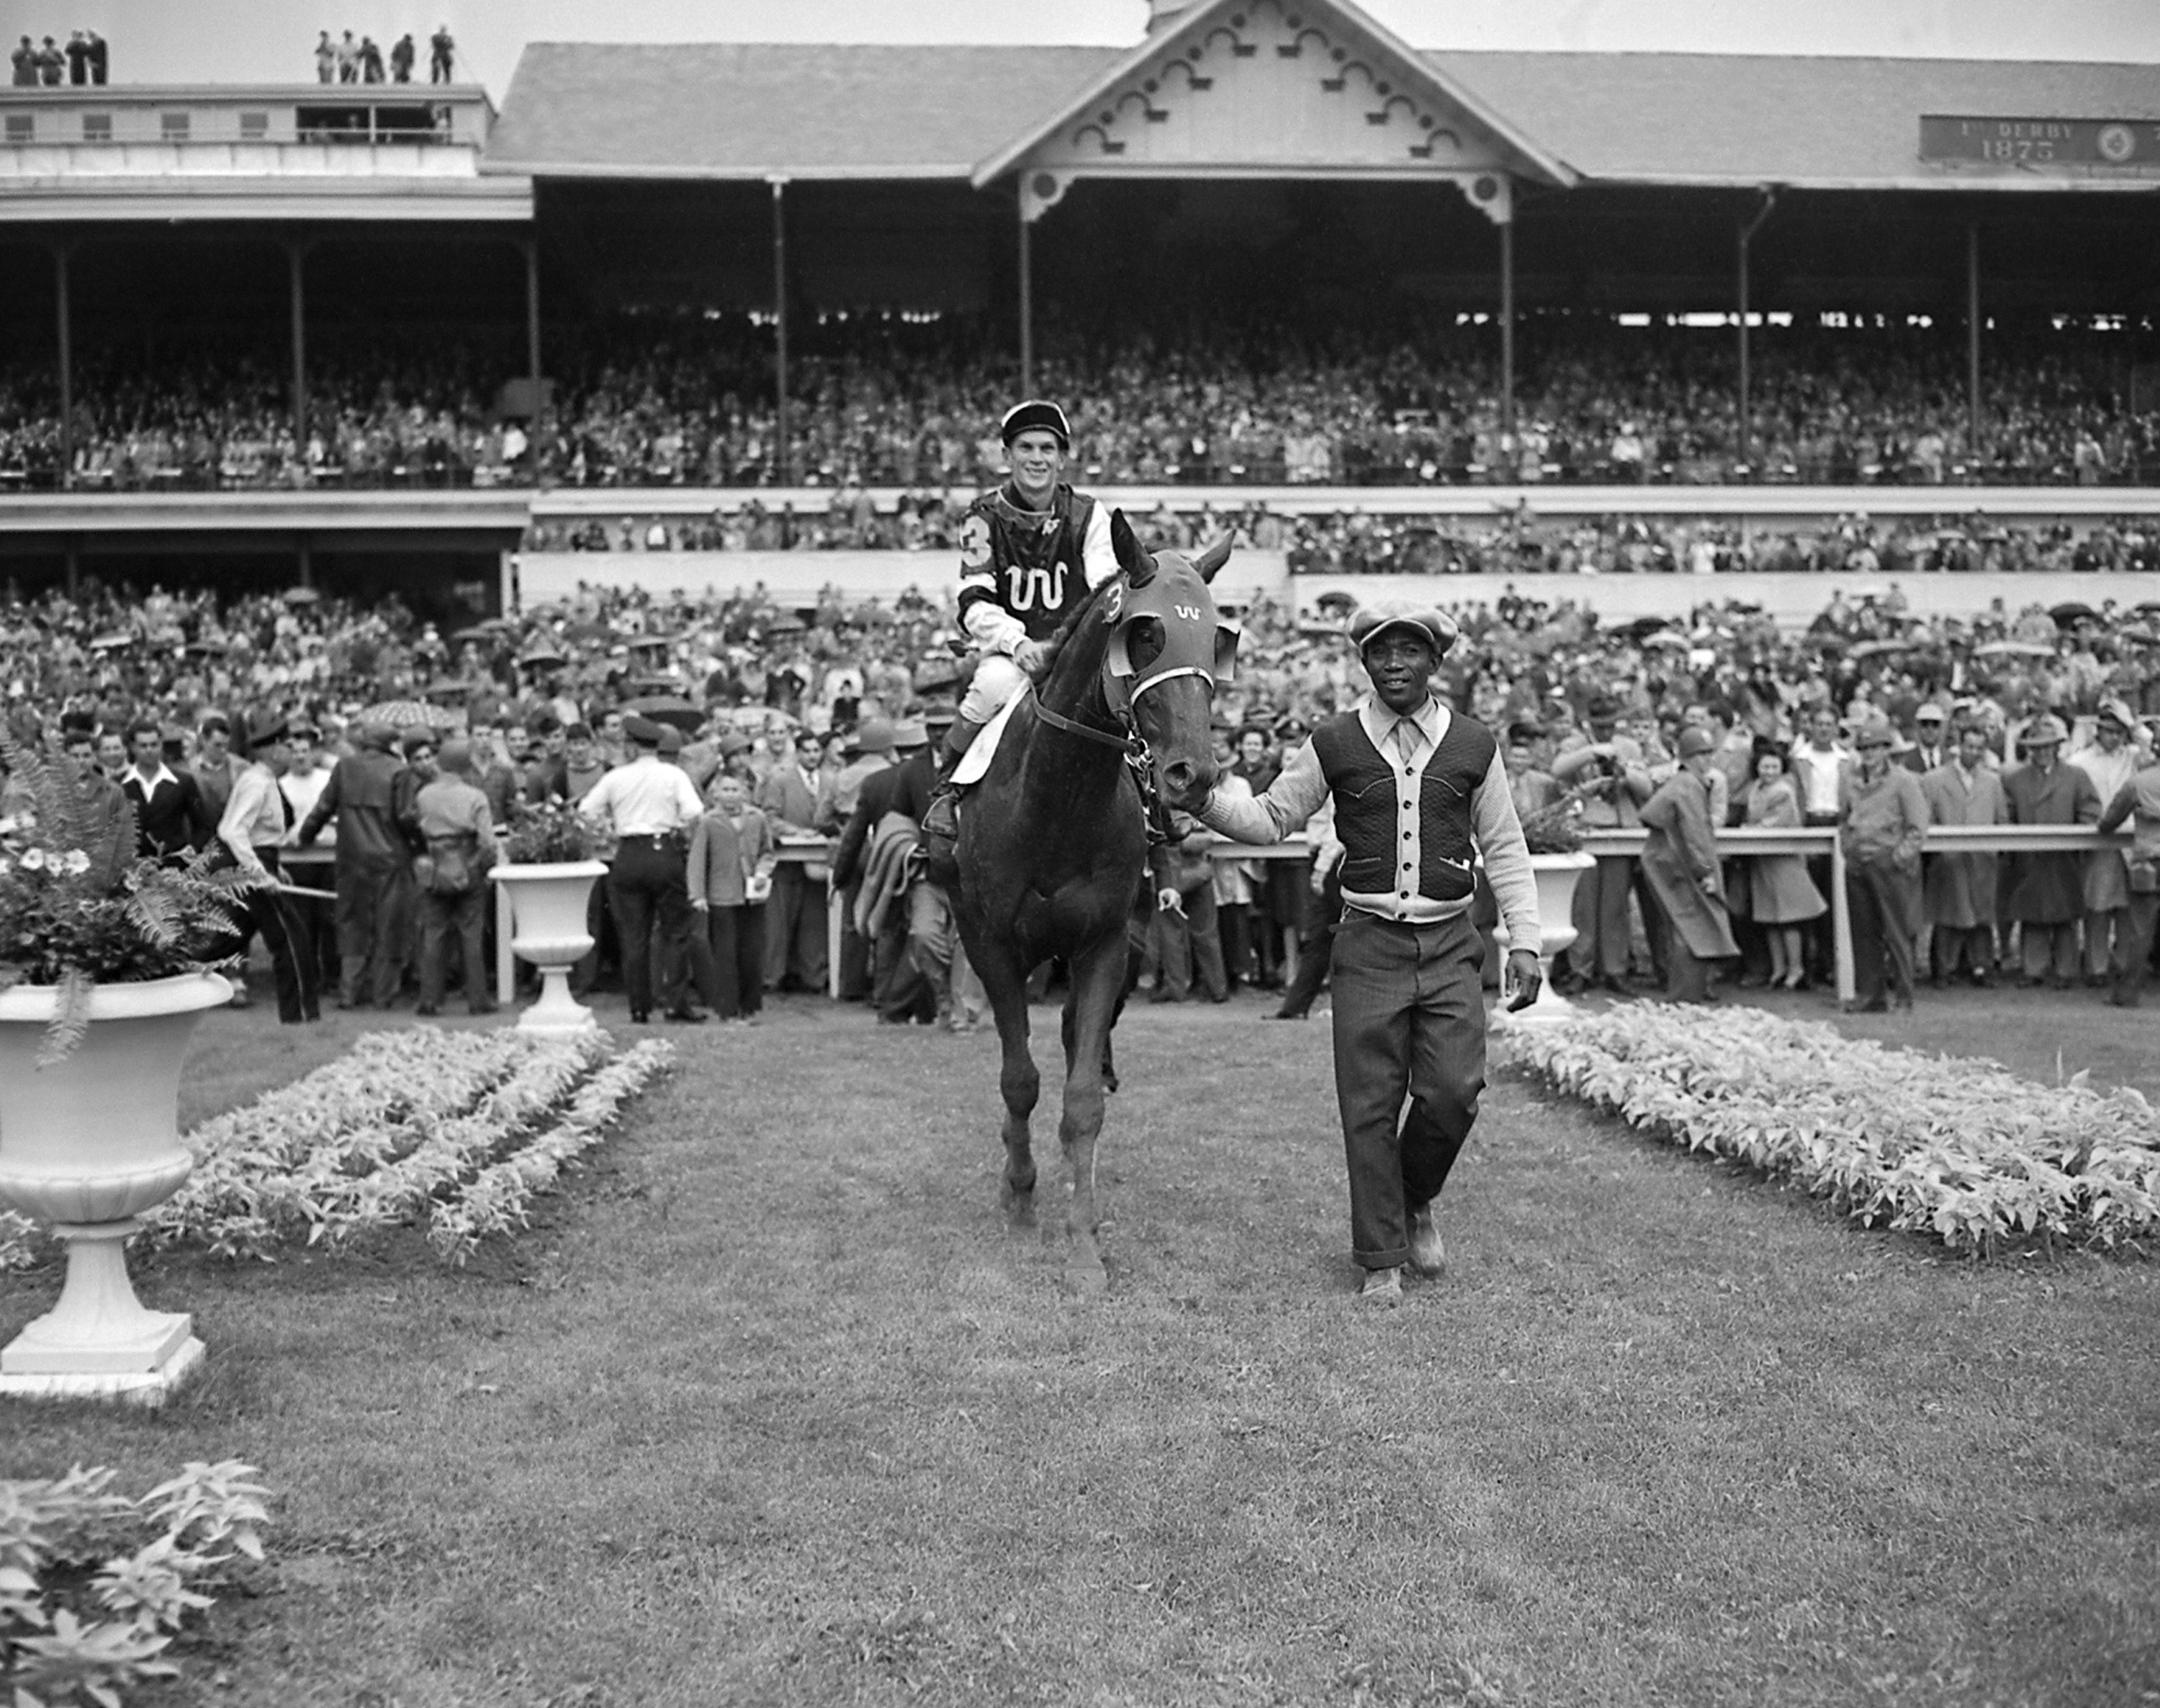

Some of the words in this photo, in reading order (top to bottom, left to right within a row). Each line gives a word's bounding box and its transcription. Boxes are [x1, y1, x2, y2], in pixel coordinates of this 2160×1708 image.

[1982, 140, 2053, 159] 1875
[960, 515, 991, 567] 3
[1005, 562, 1068, 611] W
[1107, 582, 1123, 617] 3
[1174, 604, 1201, 620] W
